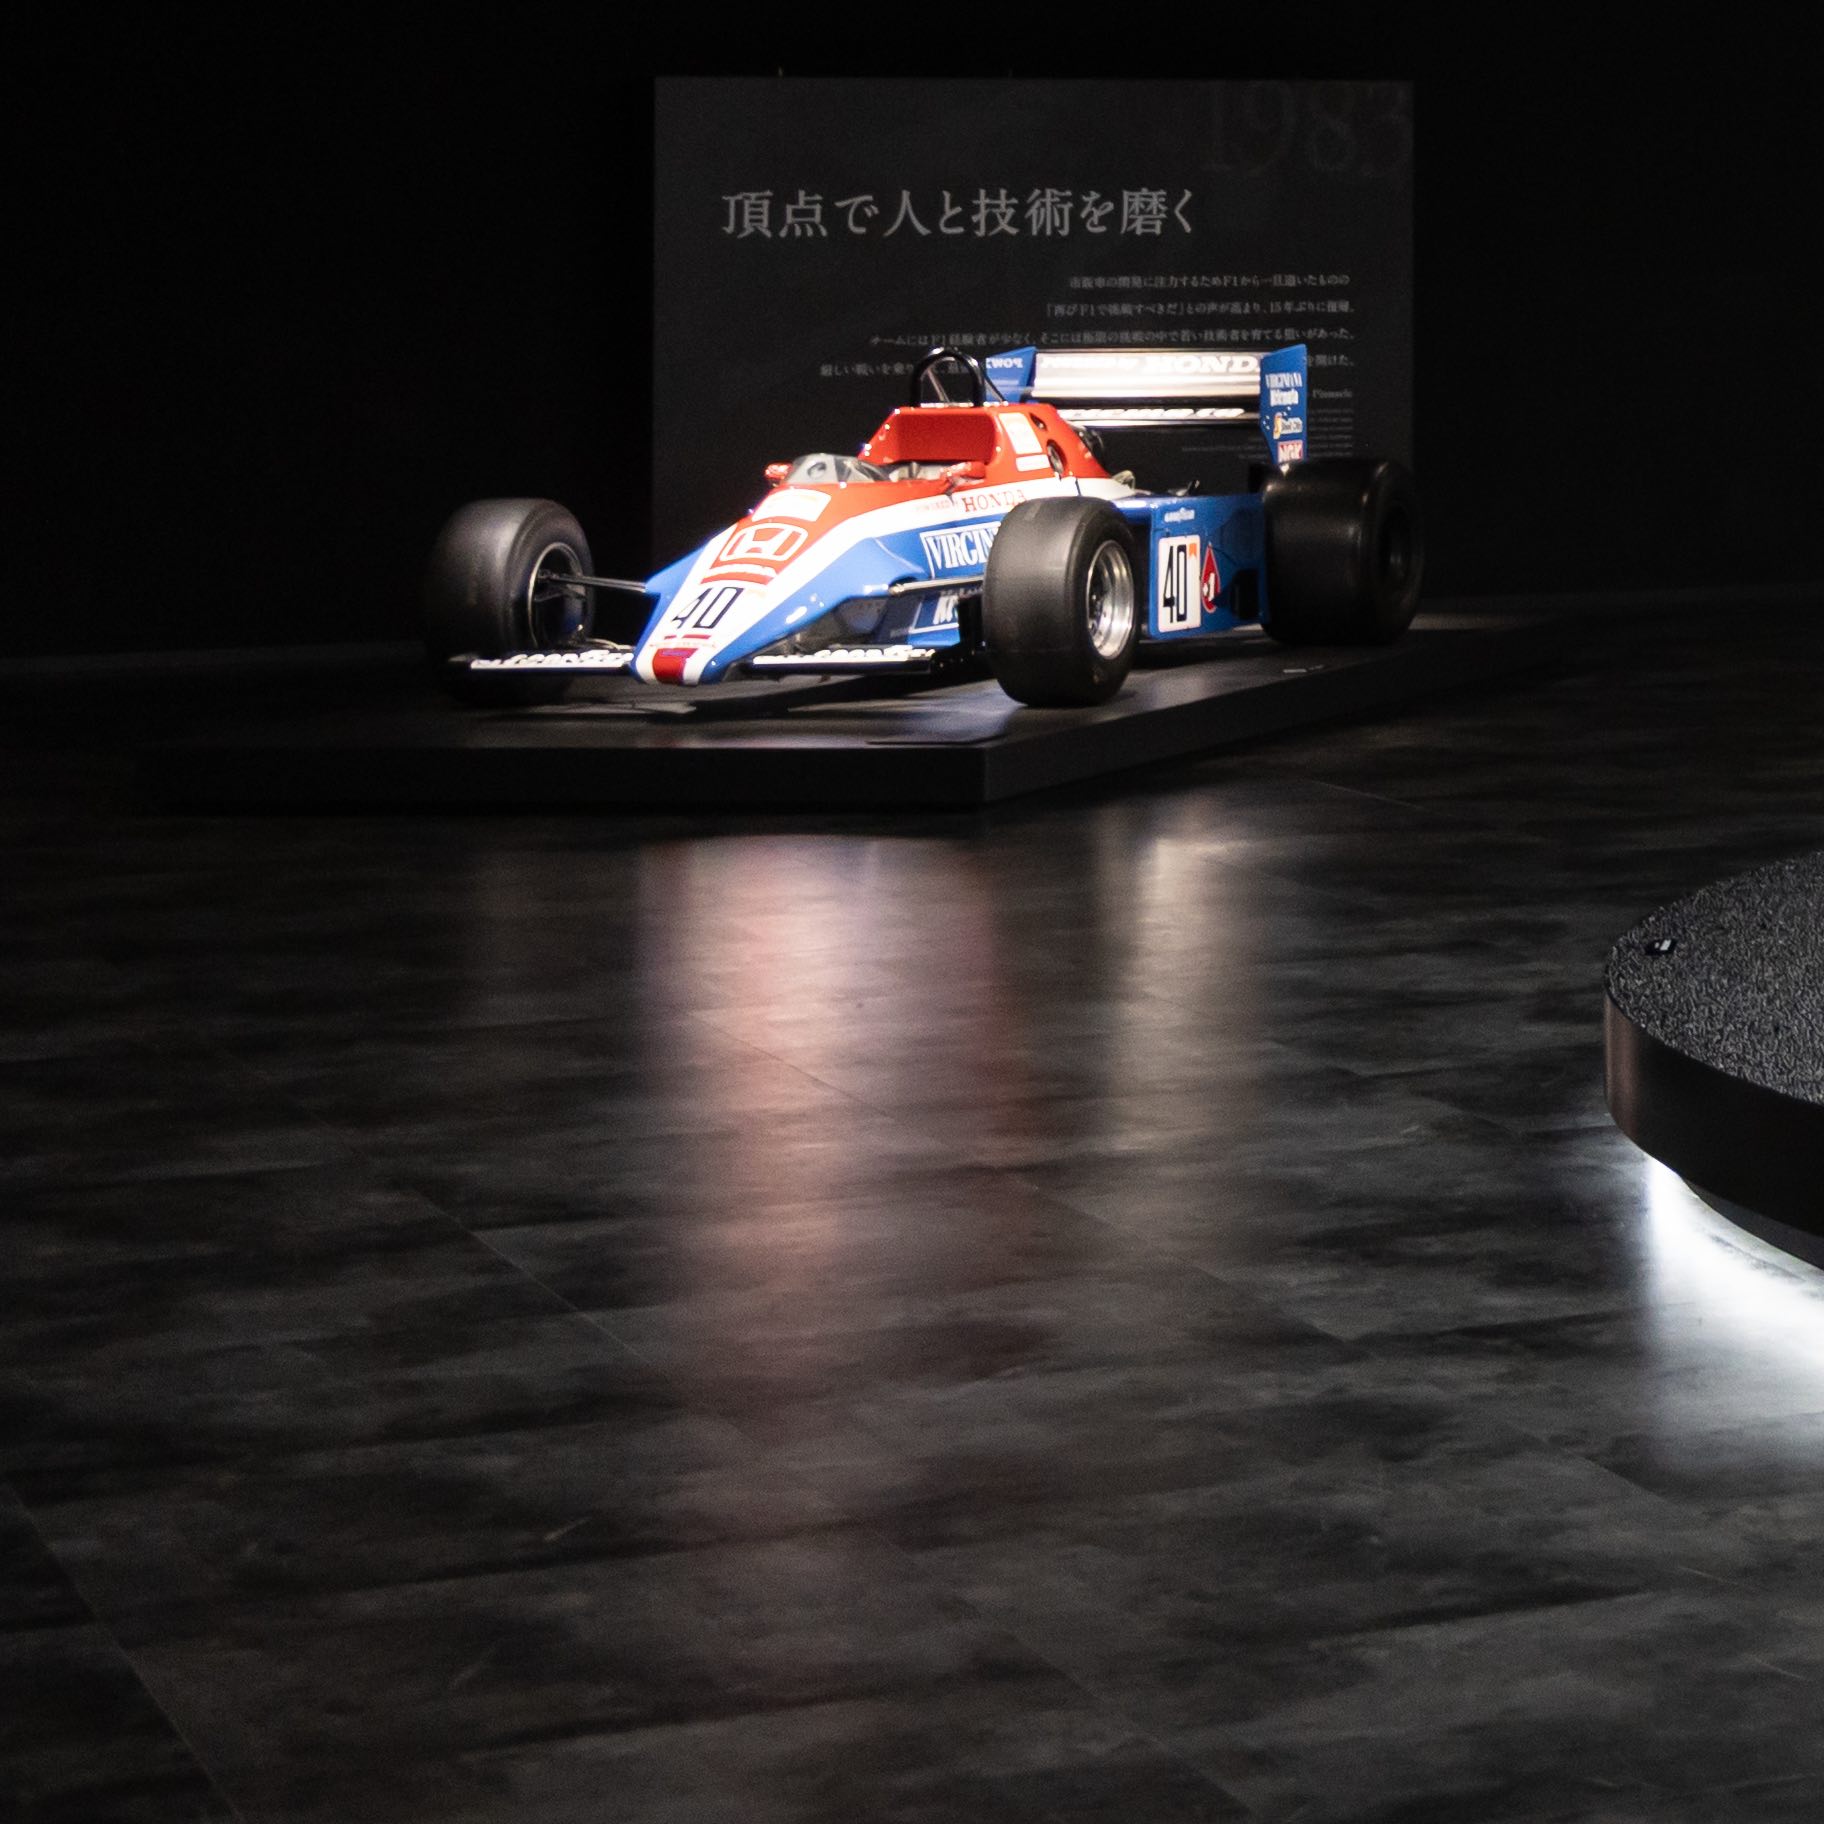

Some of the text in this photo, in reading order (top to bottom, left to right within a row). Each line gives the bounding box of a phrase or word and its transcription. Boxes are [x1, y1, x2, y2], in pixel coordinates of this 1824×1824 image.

[722, 187, 1194, 240] 頂点で人と技術を磨く
[1141, 355, 1260, 374] HOND
[927, 527, 1001, 569] VIRGIN
[1162, 543, 1187, 624] 40
[672, 587, 744, 629] 40
